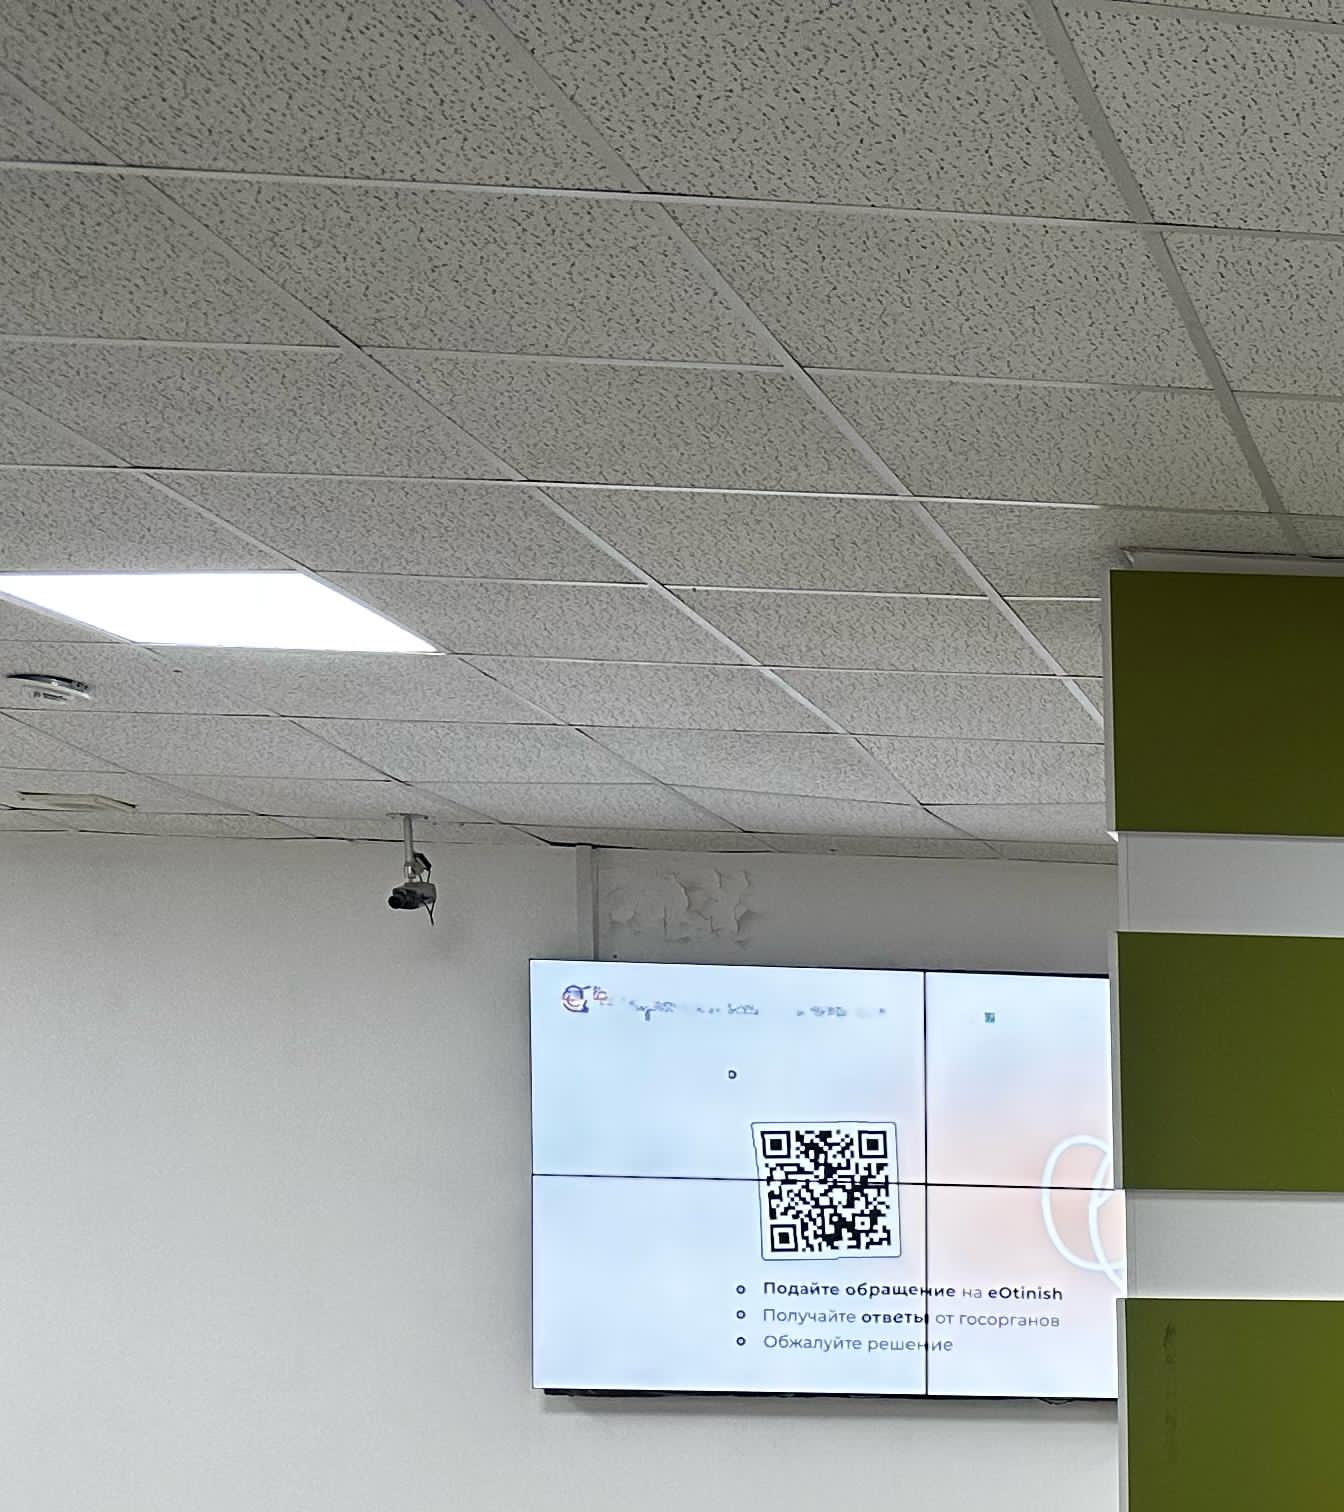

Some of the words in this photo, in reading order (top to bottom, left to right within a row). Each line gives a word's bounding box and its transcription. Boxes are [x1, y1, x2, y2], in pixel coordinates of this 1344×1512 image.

[763, 1281, 841, 1297] Подайте
[845, 1282, 956, 1299] обращение
[962, 1287, 983, 1299] на
[988, 1286, 1064, 1300] eOtinish
[763, 1308, 857, 1325] Получайте
[861, 1312, 928, 1324] ответы
[935, 1314, 955, 1325] от
[959, 1314, 1060, 1328] госорганов
[763, 1335, 863, 1352] Обжалуйте
[867, 1339, 953, 1352] решение
